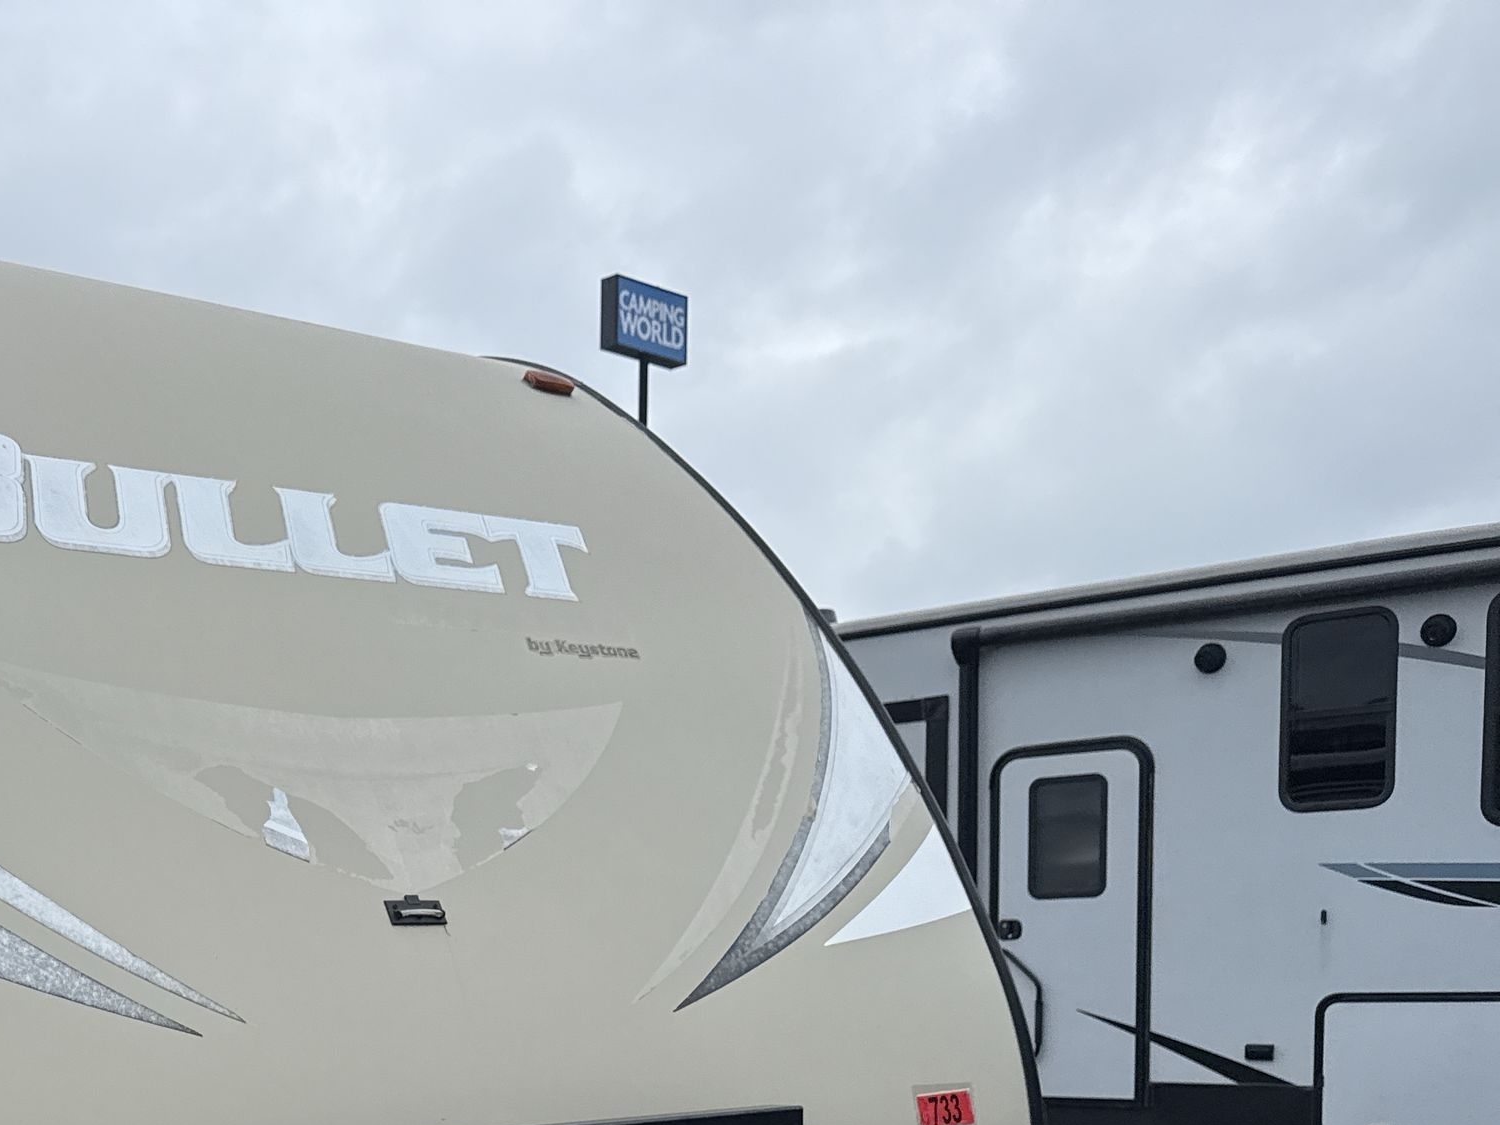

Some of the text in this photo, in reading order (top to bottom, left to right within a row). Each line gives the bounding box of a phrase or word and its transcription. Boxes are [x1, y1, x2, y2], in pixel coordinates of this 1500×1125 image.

[619, 289, 684, 328] CAMPING
[620, 309, 684, 350] WORLD
[525, 637, 640, 660] by Keystone
[927, 1094, 962, 1125] 733
